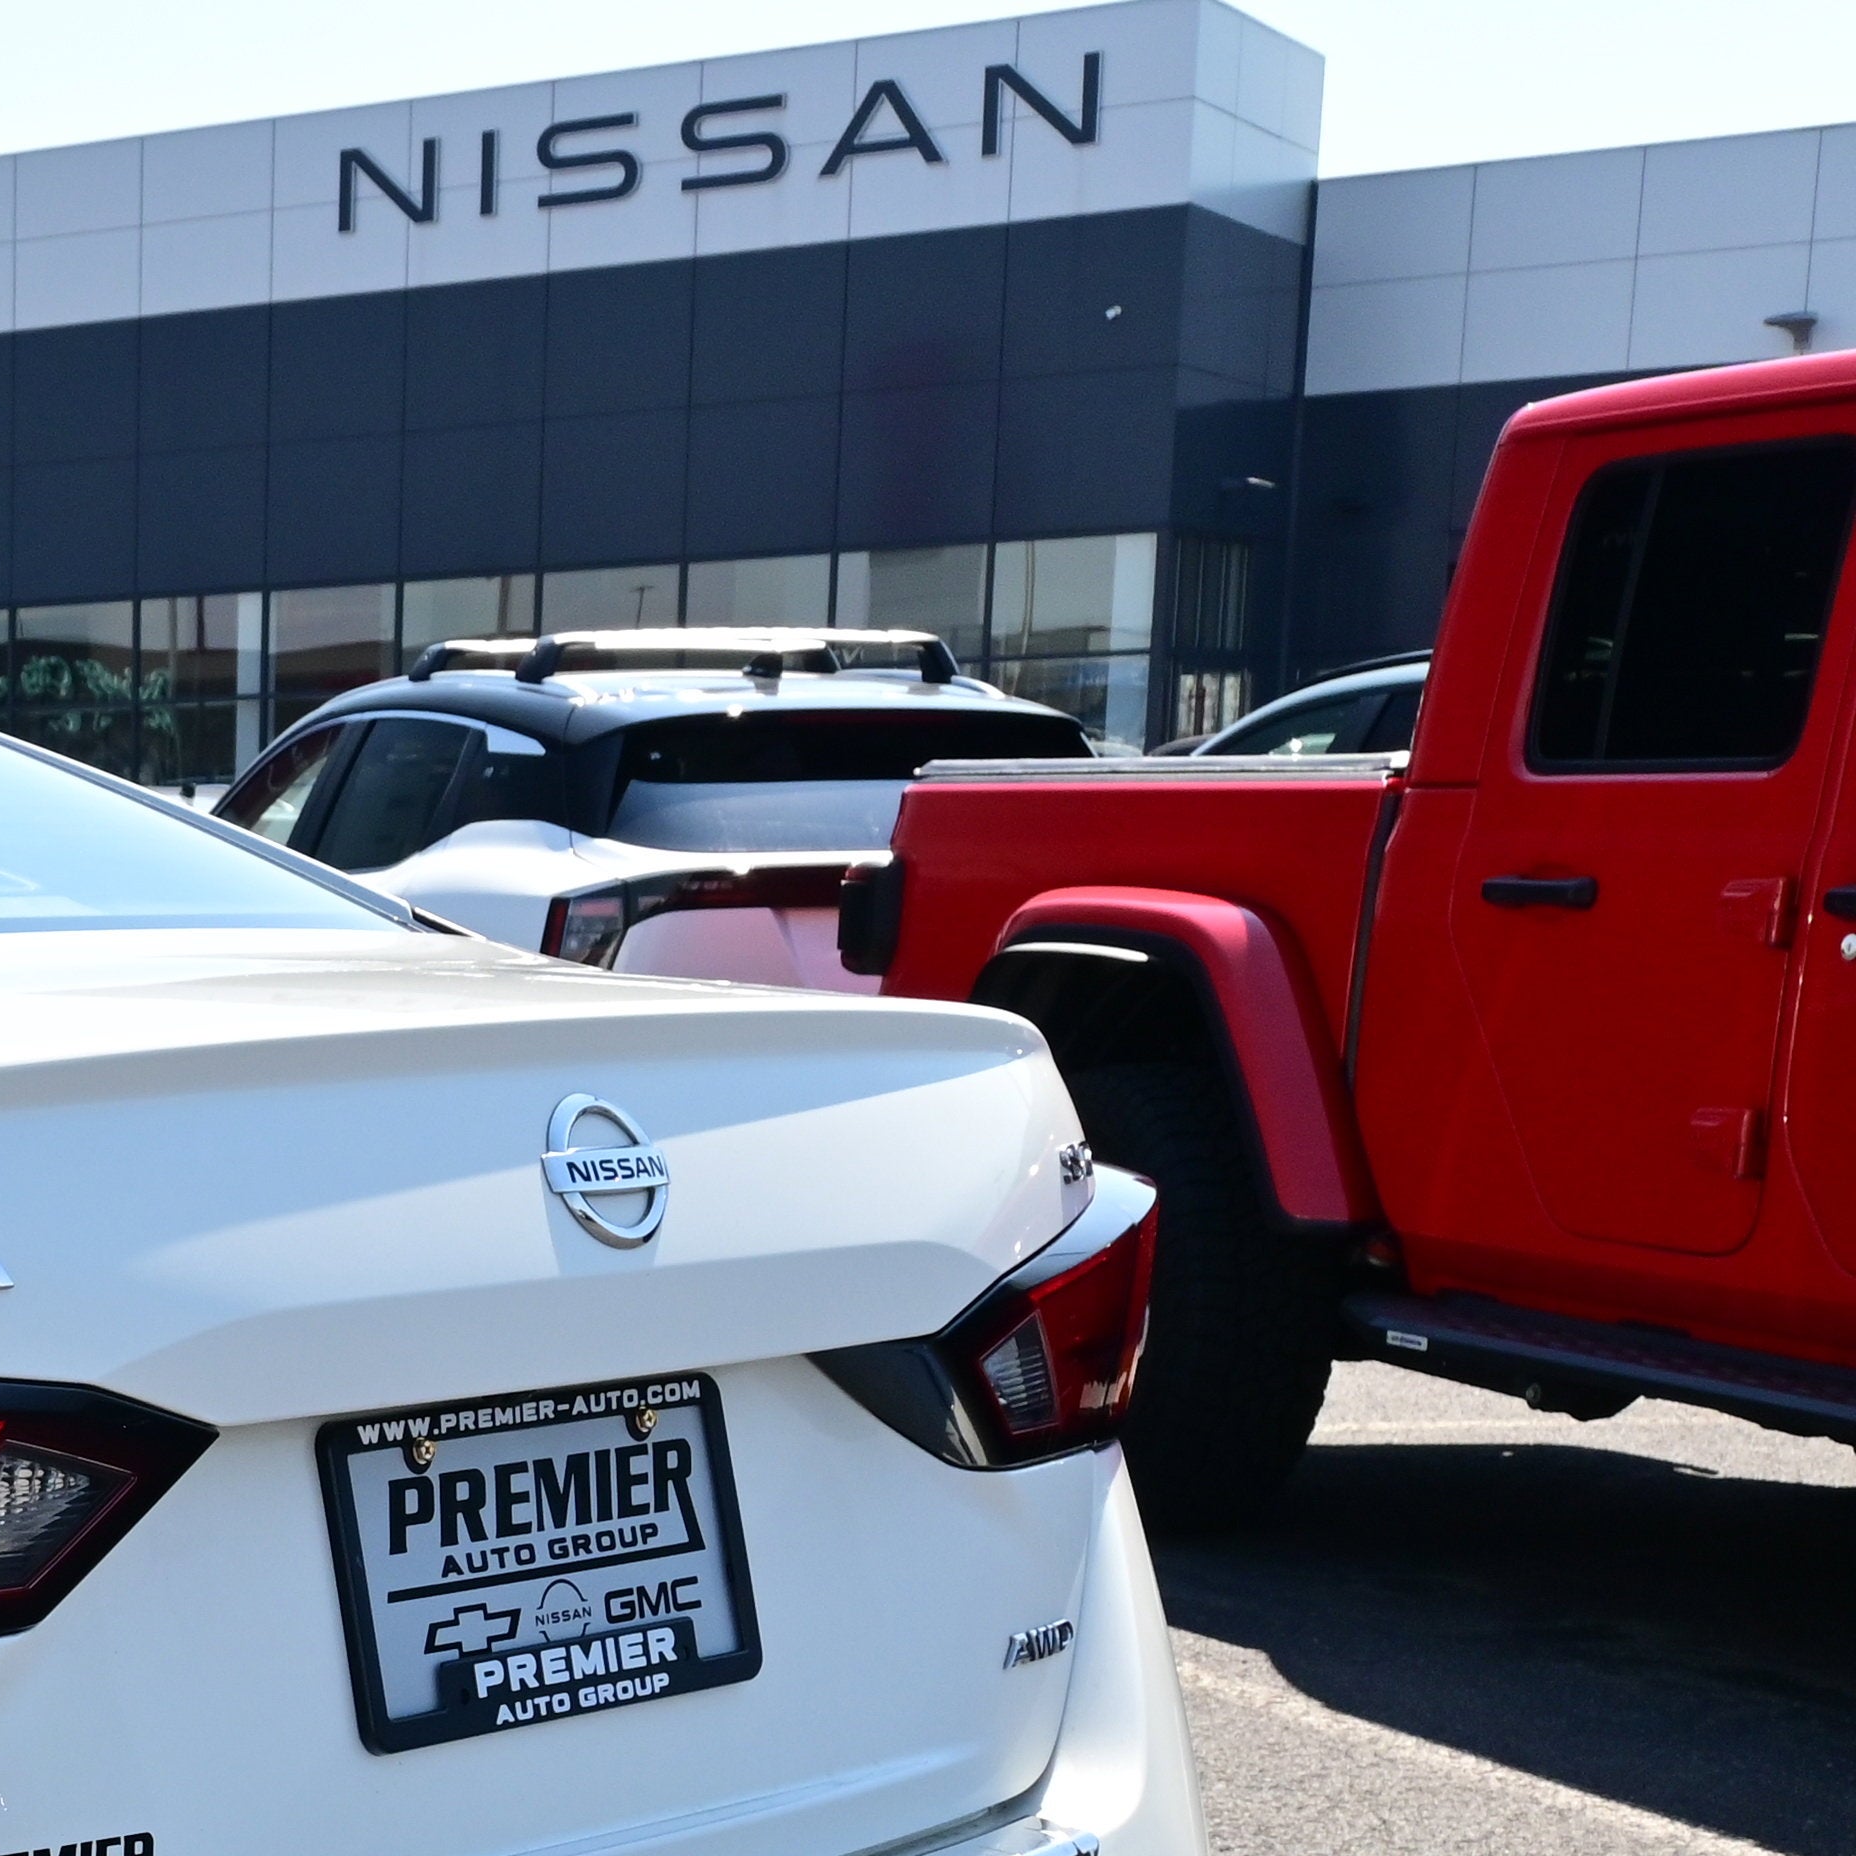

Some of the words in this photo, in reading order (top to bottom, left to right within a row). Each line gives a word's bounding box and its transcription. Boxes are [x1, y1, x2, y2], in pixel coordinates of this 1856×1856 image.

[338, 51, 1103, 232] NISSAN
[566, 1155, 665, 1183] NISSAN
[357, 1379, 701, 1446] WWW.PREMIER-AUTO.COM
[388, 1438, 706, 1556] PREMIER
[440, 1542, 536, 1578] AUTO
[548, 1522, 659, 1561] GROUP
[535, 1605, 592, 1627] NISSAN
[604, 1576, 703, 1624] GMC
[474, 1627, 677, 1699] PREMIER
[1002, 1618, 1074, 1670] AWD
[496, 1692, 572, 1726] AUTO
[578, 1672, 670, 1708] GROUP
